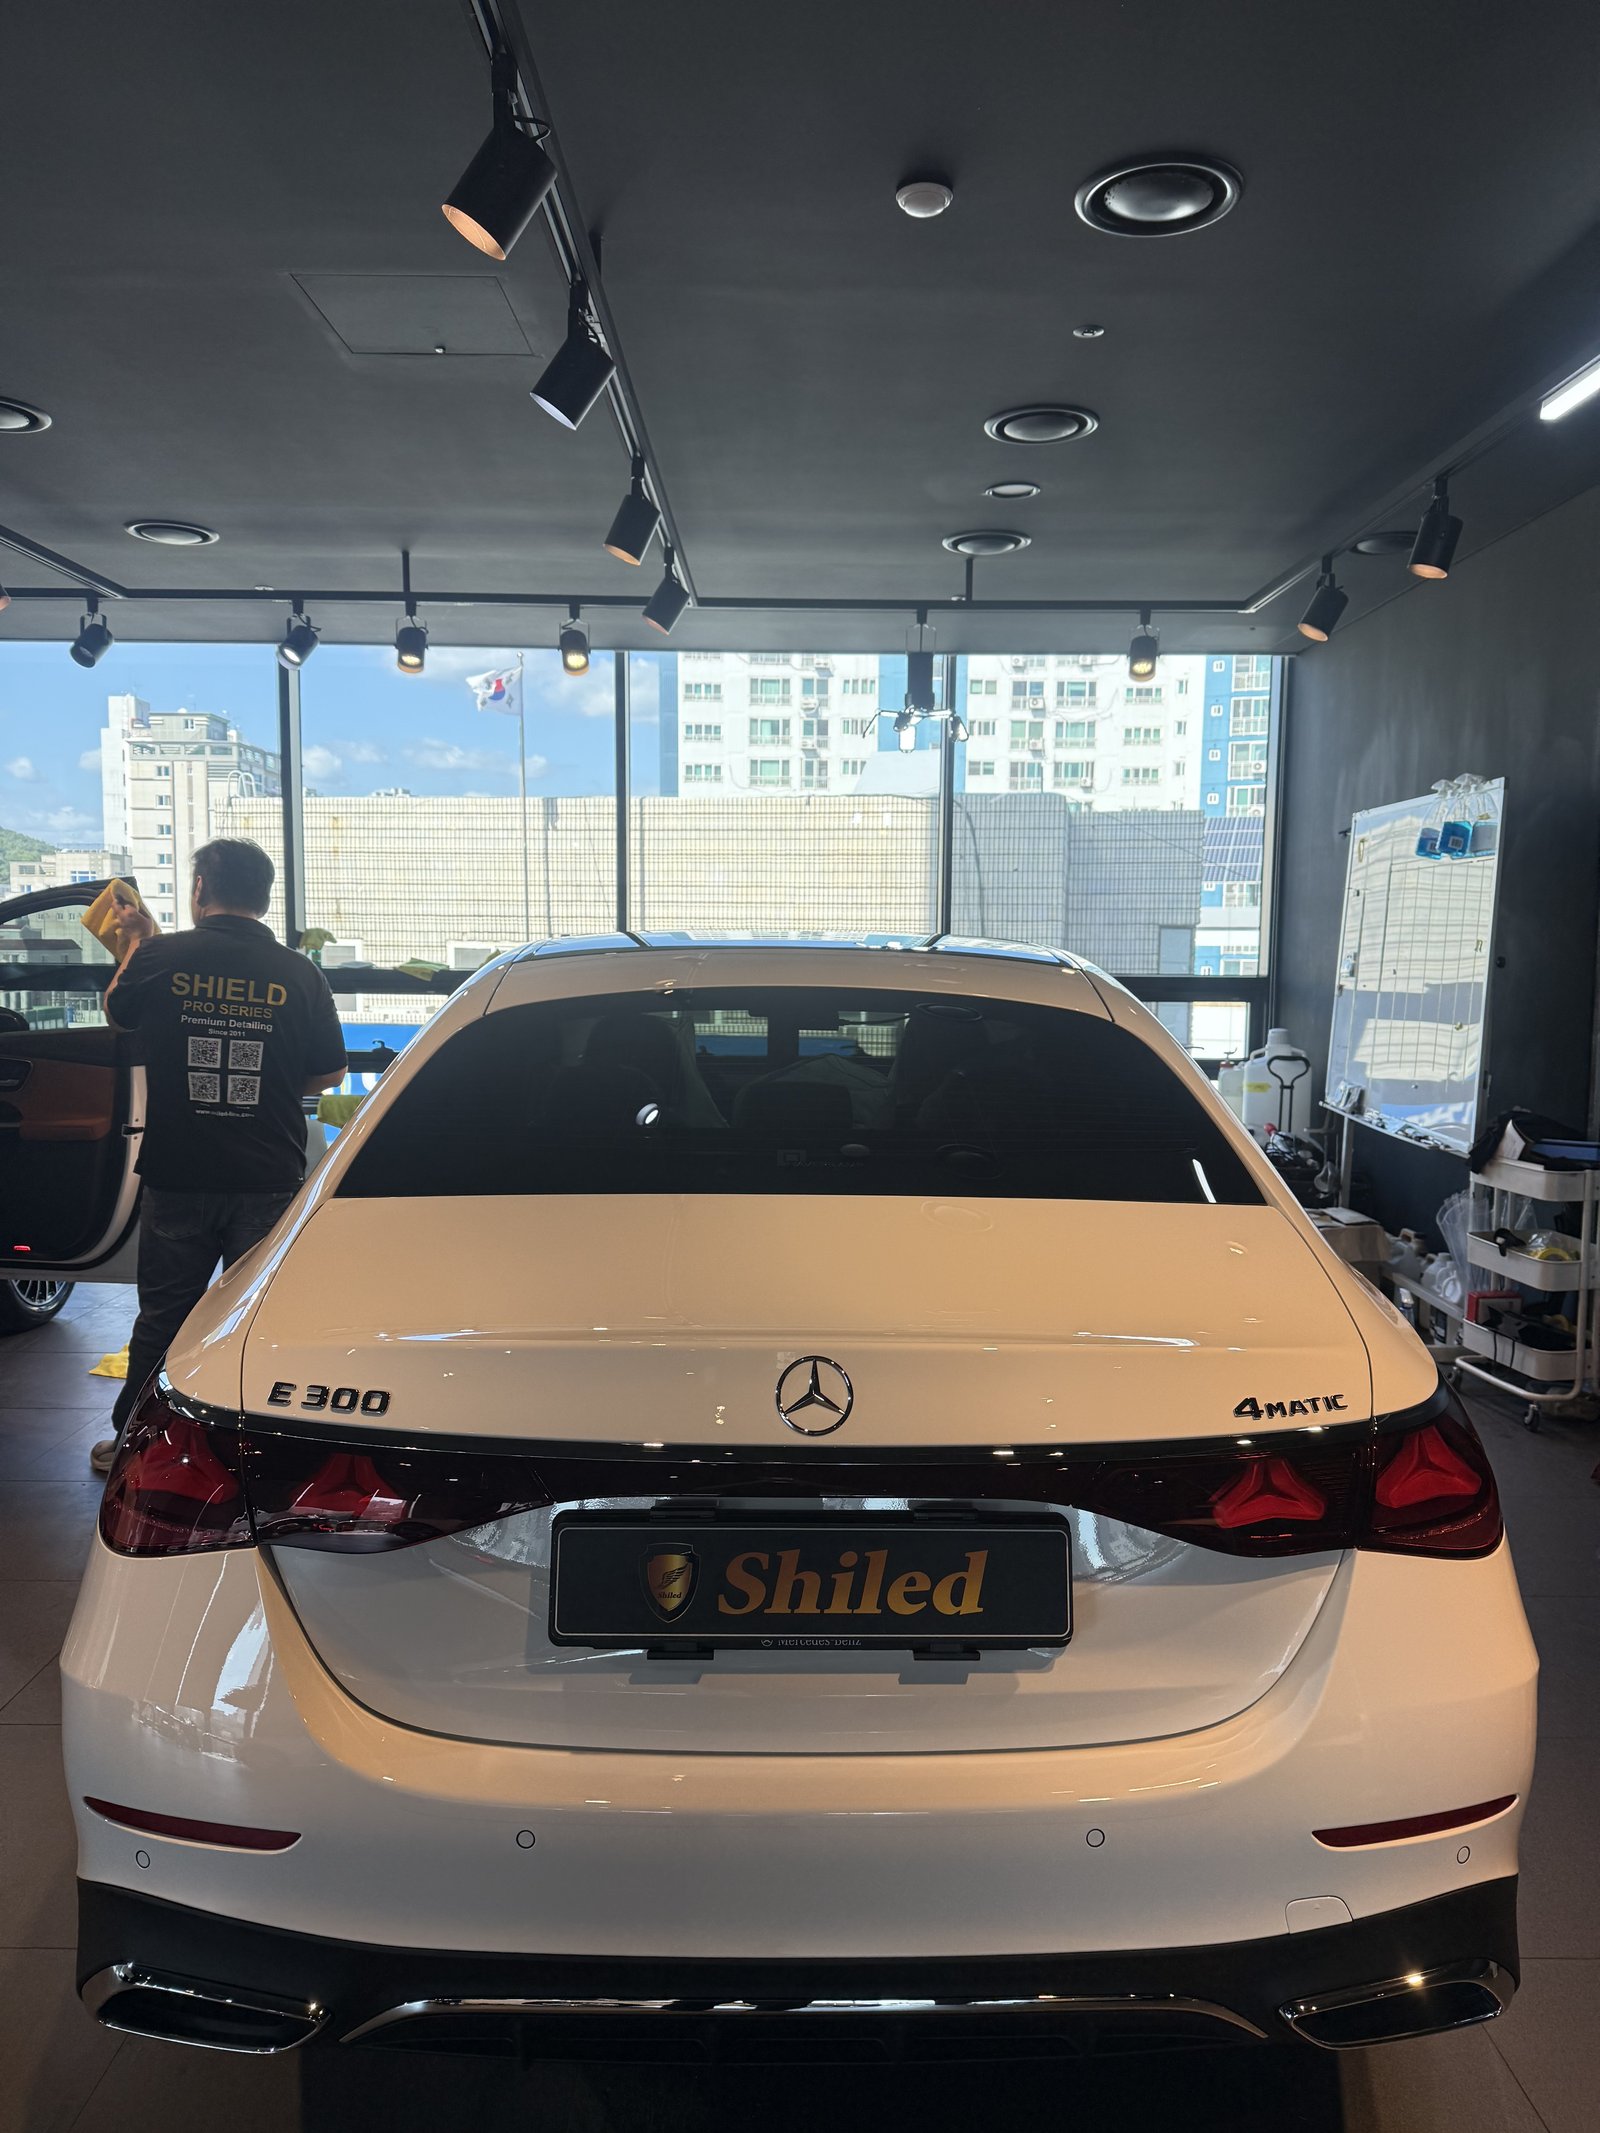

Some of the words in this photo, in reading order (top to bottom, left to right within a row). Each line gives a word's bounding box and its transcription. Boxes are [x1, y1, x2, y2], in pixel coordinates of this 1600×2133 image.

[171, 972, 287, 1006] SHIELD
[183, 1000, 215, 1014] PRO
[219, 1004, 273, 1019] SERIES
[181, 1015, 226, 1027] Premium
[229, 1019, 273, 1032] Detailing
[208, 1028, 228, 1036] Since
[267, 1381, 297, 1407] E
[301, 1384, 391, 1417] 300
[1233, 1394, 1348, 1420] 4MATIC
[718, 1549, 989, 1616] Shiled
[658, 1591, 682, 1599] Shiled
